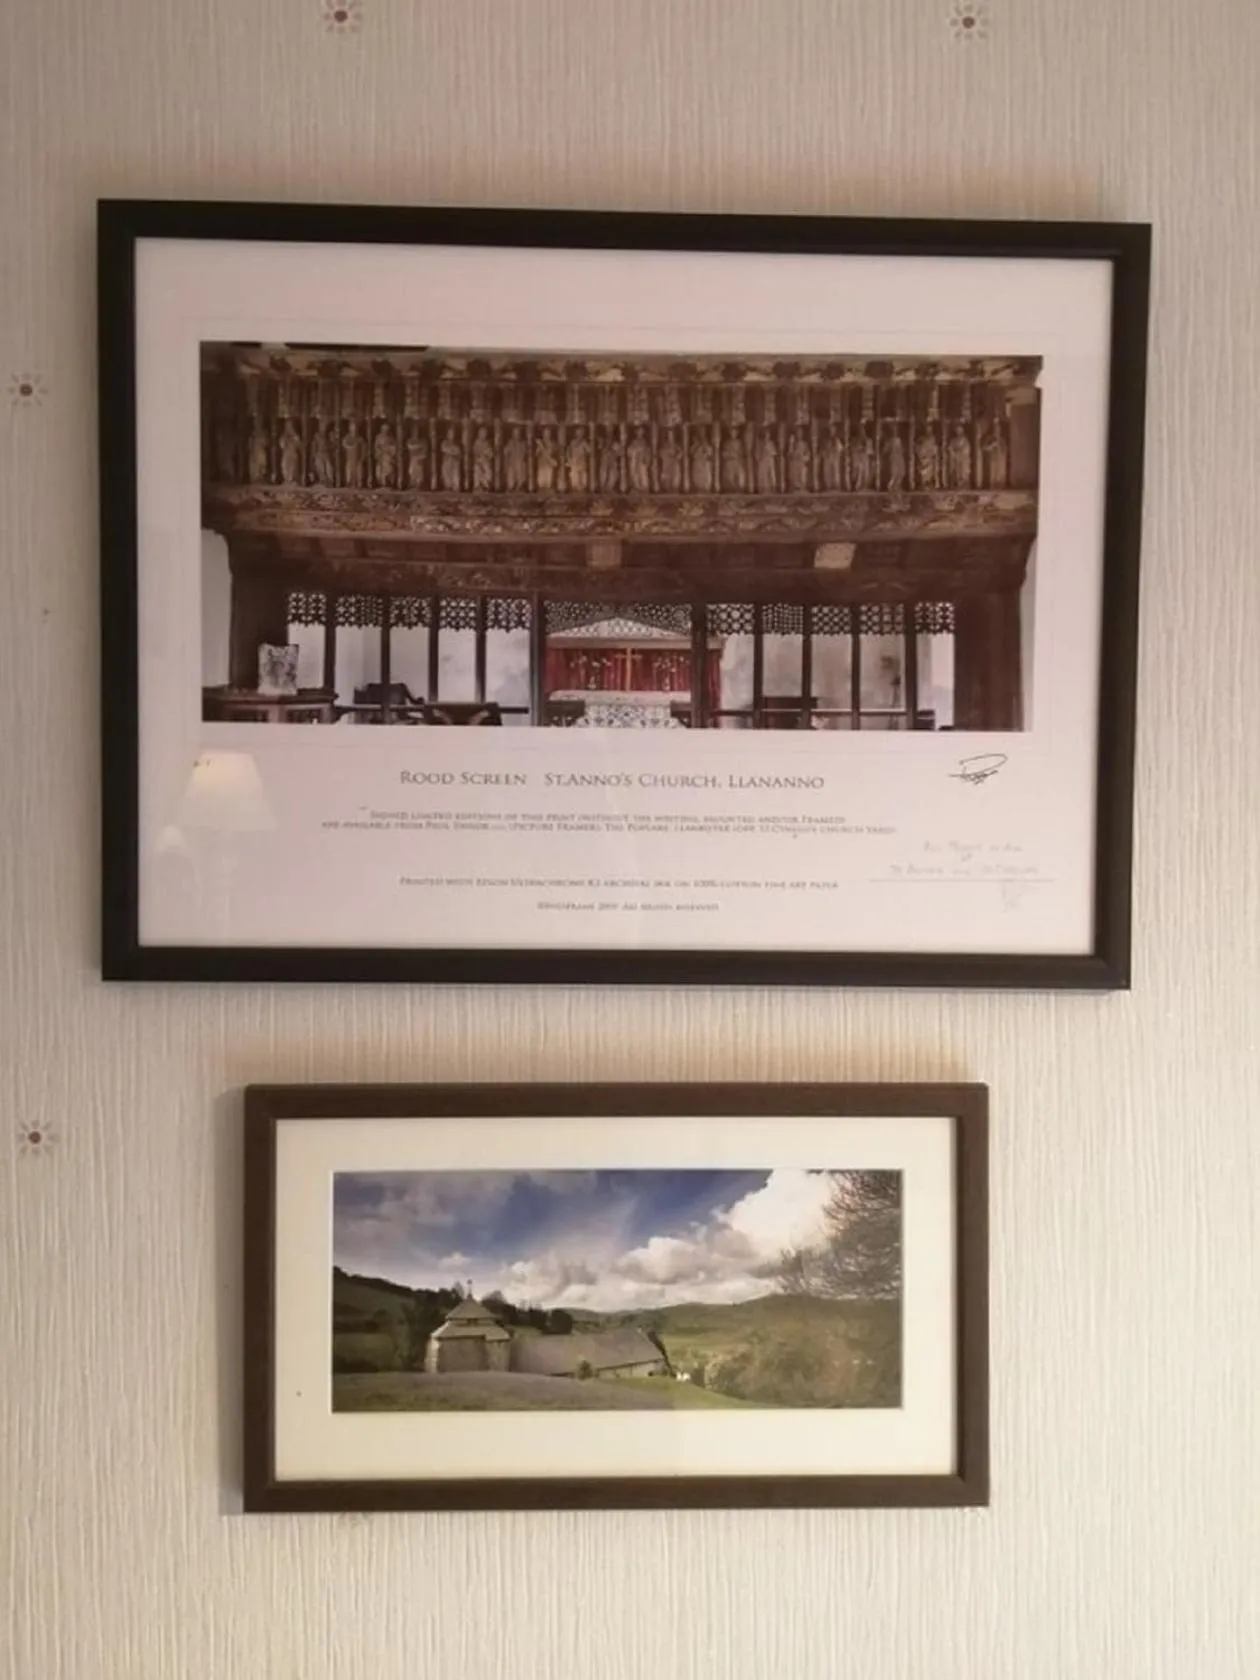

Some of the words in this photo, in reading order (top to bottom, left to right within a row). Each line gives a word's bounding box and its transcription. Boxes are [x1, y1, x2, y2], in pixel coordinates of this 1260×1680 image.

[400, 771, 455, 785] ROOD
[460, 772, 526, 785] SCREEN
[729, 774, 825, 789] LLANANNO
